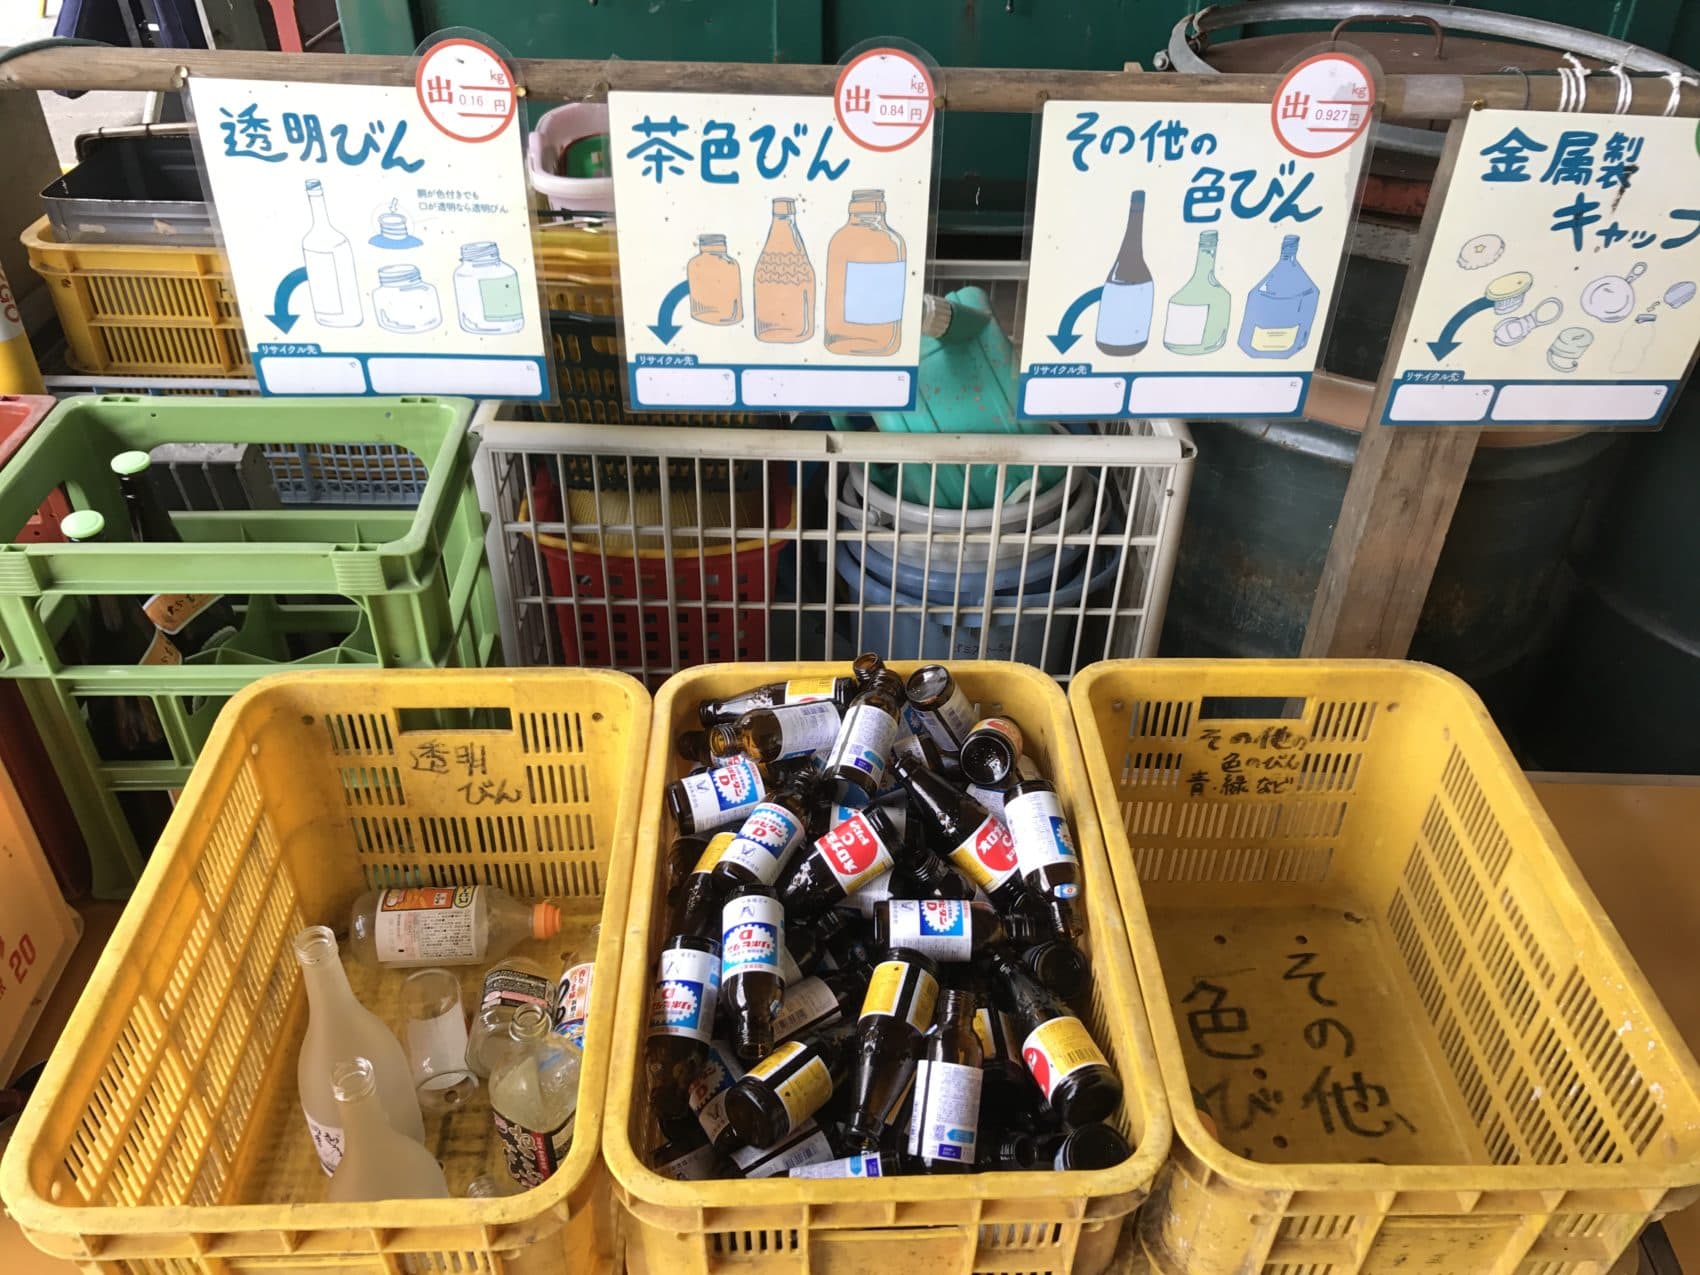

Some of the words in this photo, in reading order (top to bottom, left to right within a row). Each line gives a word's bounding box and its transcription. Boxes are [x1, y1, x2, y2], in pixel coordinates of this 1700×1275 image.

[490, 69, 505, 85] kg
[910, 79, 926, 94] kg
[427, 76, 453, 105] 出
[845, 85, 870, 114] 出
[1351, 83, 1368, 99] kg
[494, 99, 506, 112] 円
[879, 104, 904, 117] 0.84
[910, 108, 922, 121] 円
[1281, 91, 1311, 120] 出
[1315, 109, 1348, 121] 0.927
[219, 102, 425, 173] 透明びん
[626, 115, 850, 184] 茶色びん
[1066, 111, 1218, 172] その他の
[1479, 127, 1644, 190] 金属製
[1183, 160, 1323, 224] 色びん
[261, 344, 318, 355] リサイクル先
[639, 355, 695, 367] リサイクル先
[1032, 365, 1087, 375] リサイクル先
[1200, 726, 1306, 750] その他の
[410, 739, 487, 776] 透明
[1221, 753, 1299, 773] 色のびん
[457, 779, 521, 805] びん
